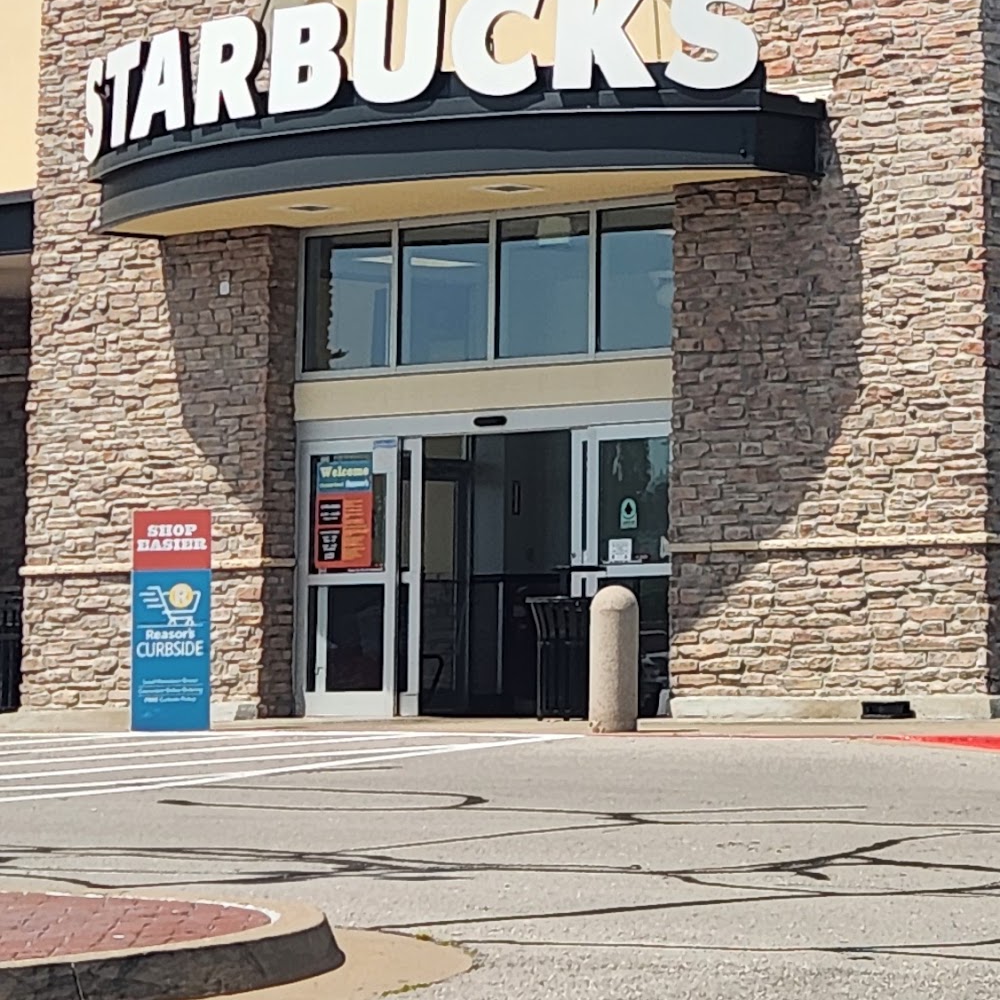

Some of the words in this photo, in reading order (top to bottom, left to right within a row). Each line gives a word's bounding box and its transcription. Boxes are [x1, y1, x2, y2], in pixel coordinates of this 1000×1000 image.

[320, 465, 369, 478] Welcome
[147, 524, 198, 537] SHOP
[136, 537, 208, 552] EASIER
[145, 627, 196, 640] Reasor's
[136, 640, 204, 658] CURBSIDE
